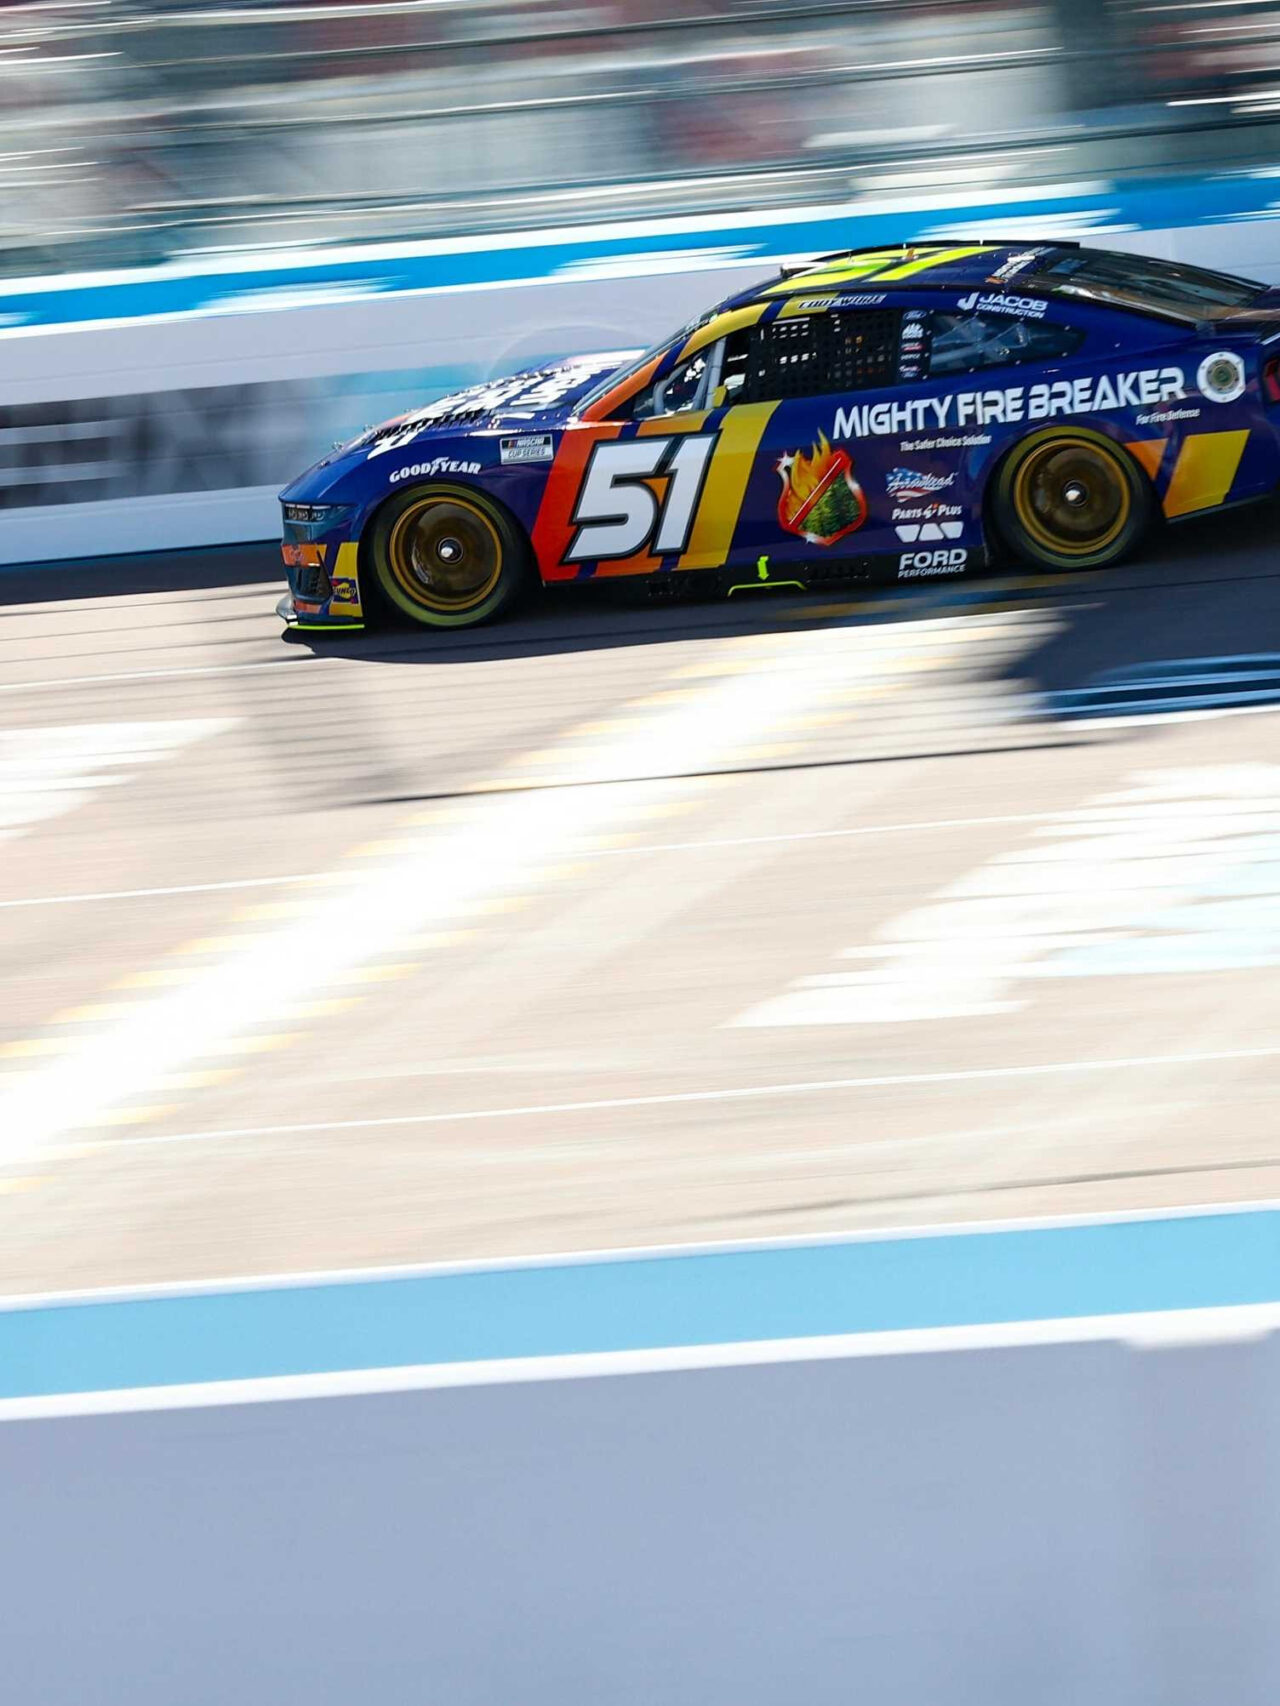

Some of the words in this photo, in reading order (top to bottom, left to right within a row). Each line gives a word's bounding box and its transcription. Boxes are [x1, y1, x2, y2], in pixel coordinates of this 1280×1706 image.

[976, 304, 1045, 319] CONSTRUCTION
[979, 293, 1048, 311] JACOB
[833, 395, 953, 440] MIGHTY
[956, 386, 1024, 427] FIRE
[1028, 366, 1187, 420] BREAKER
[389, 456, 482, 483] GOODYEAR
[562, 432, 721, 562] 51
[937, 504, 962, 517] PLUS
[899, 548, 968, 570] FORD
[897, 564, 966, 578] PERFORMANCE
